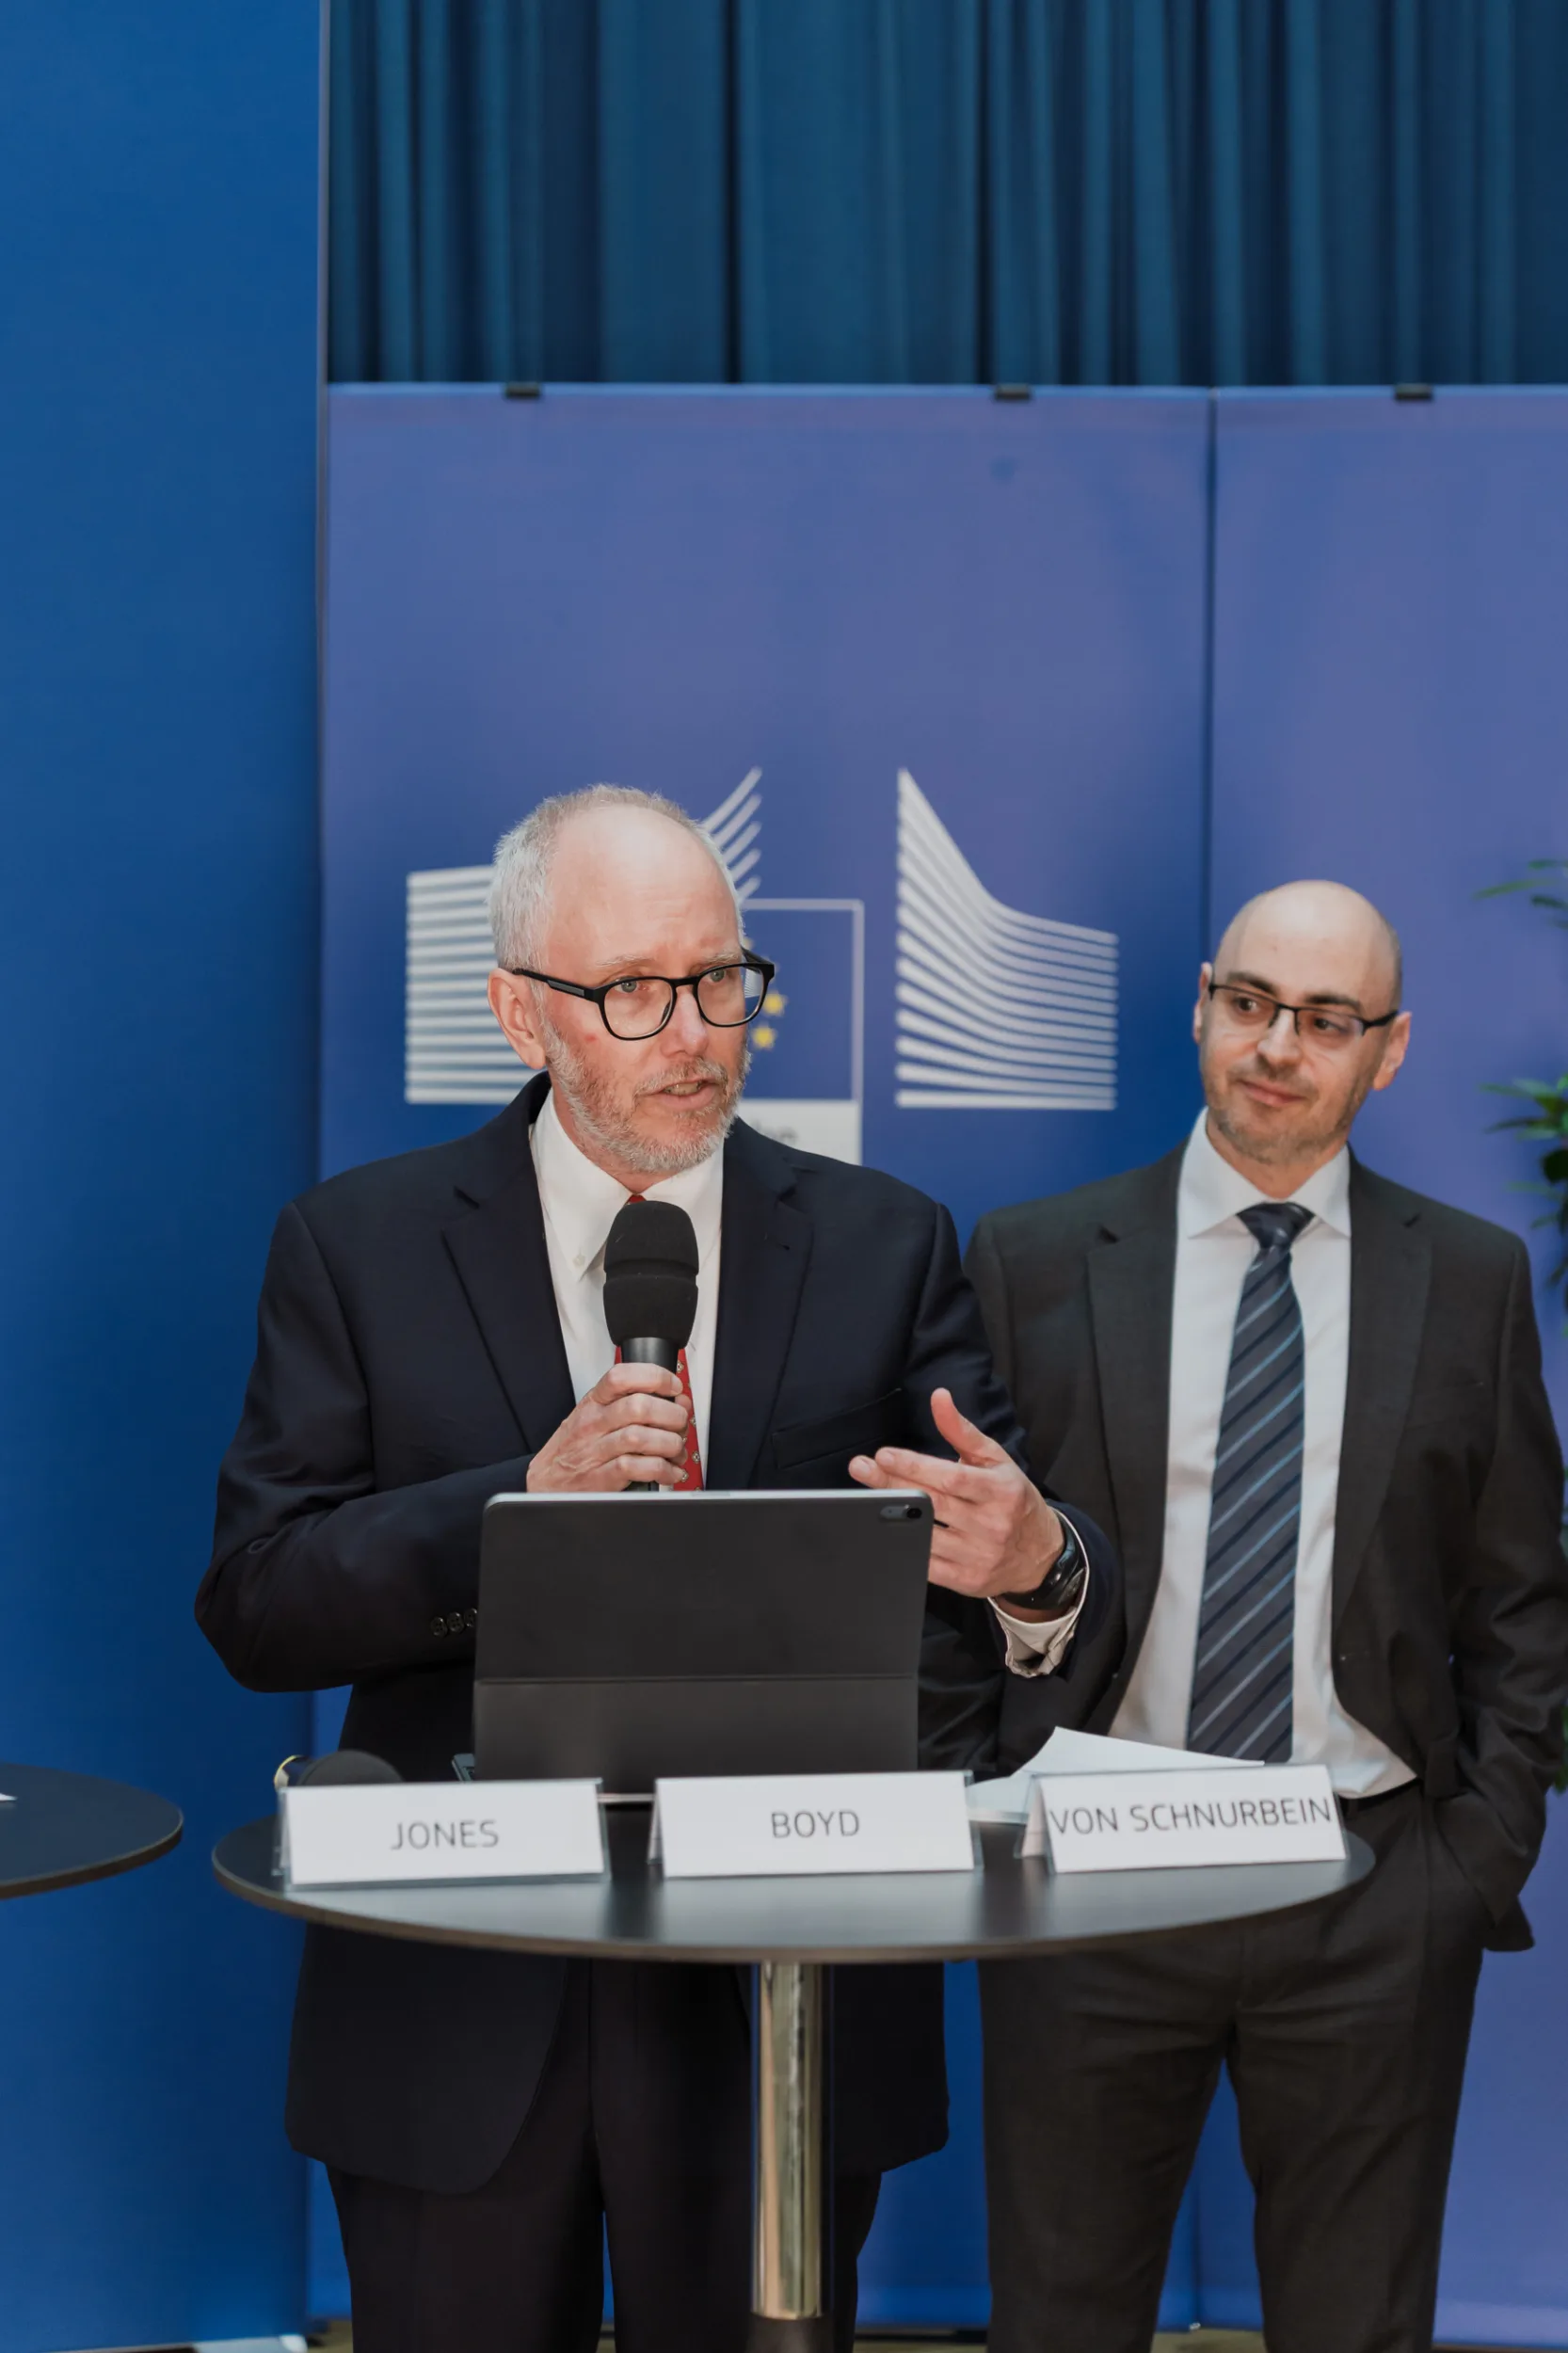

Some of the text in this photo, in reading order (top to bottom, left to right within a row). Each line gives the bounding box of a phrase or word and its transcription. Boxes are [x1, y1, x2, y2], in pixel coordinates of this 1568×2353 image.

[770, 1809, 861, 1840] BOYD
[1048, 1796, 1334, 1836] VON SCHNURBEIN
[391, 1818, 500, 1851] JONES
